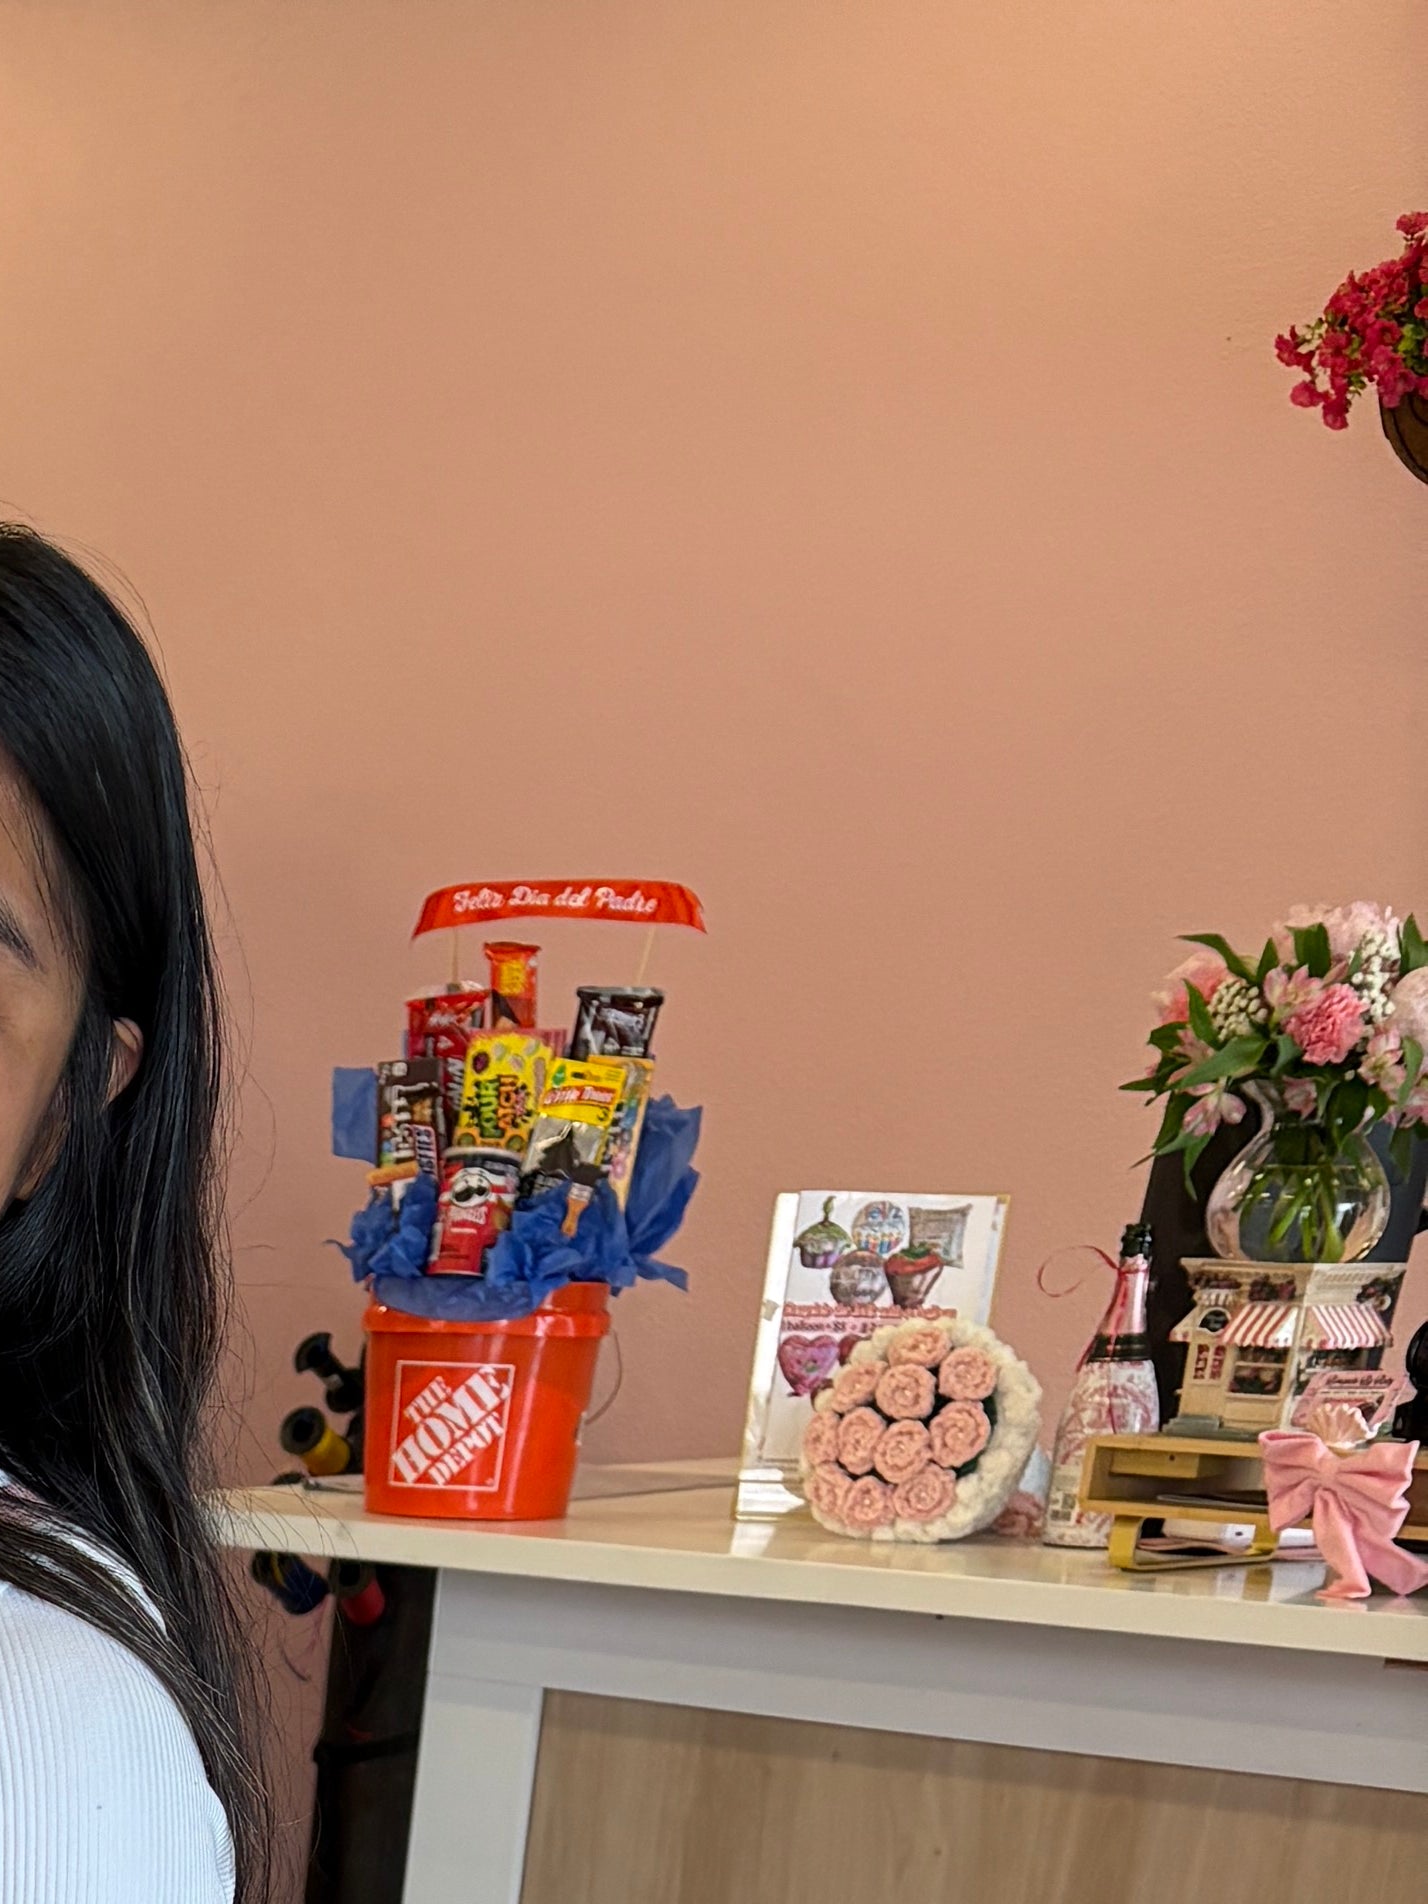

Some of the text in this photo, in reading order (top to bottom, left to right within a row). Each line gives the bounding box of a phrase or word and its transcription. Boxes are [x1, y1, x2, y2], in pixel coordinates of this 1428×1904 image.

[453, 888, 504, 913] Feliz
[552, 886, 592, 908] del
[594, 886, 658, 913] Padre
[392, 1366, 511, 1484] HOME
[404, 1375, 452, 1424] THE
[428, 1412, 504, 1487] DEPOT
